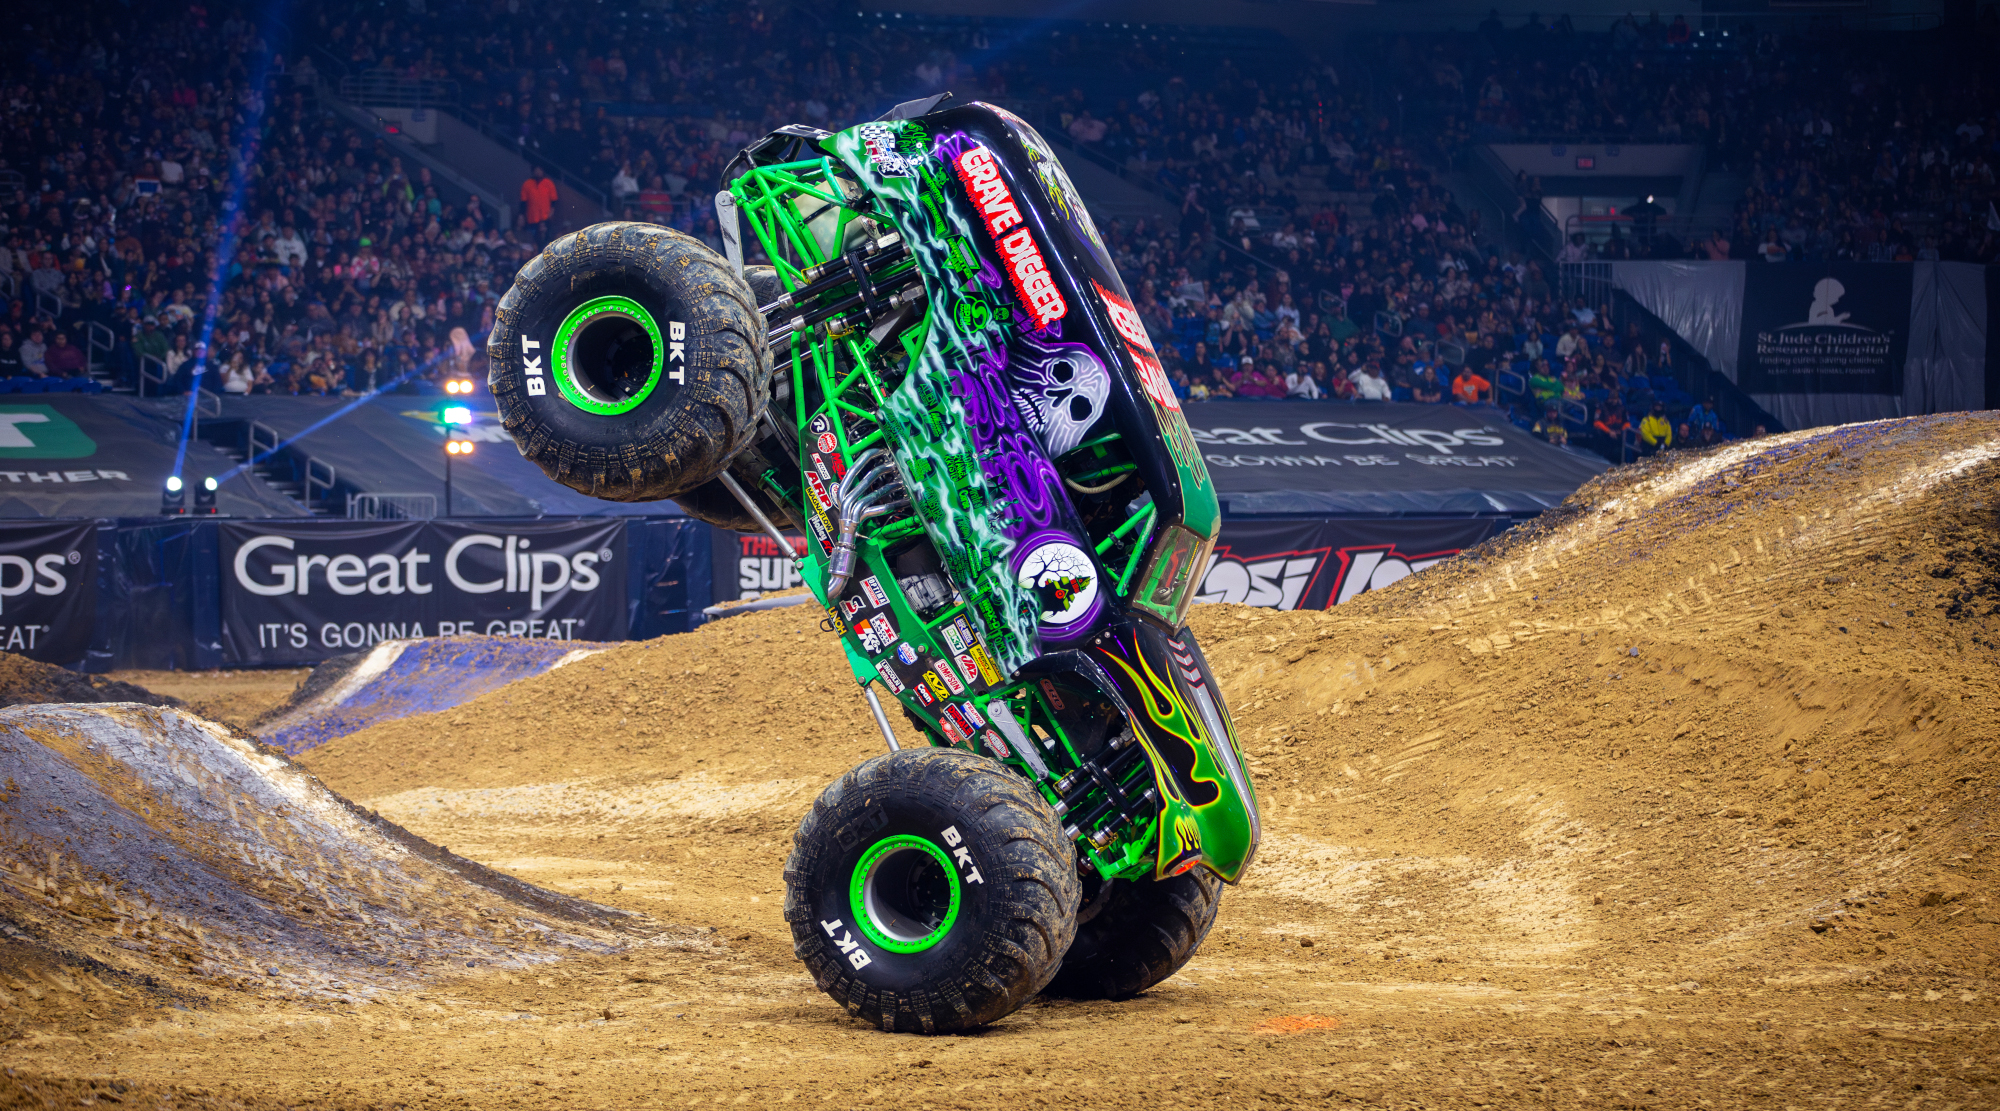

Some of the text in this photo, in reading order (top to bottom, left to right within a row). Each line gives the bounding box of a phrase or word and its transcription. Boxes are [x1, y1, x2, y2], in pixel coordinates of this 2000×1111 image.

[957, 146, 1066, 328] GRAVE DIGGER
[962, 302, 972, 326] SPIN
[1757, 344, 1889, 356] Research Hospital
[1758, 332, 1890, 345] St. Jude Children's
[521, 335, 546, 397] BKT
[669, 321, 685, 385] BKT
[1759, 356, 1791, 365] Finding
[920, 381, 938, 407] ALIEN
[959, 450, 977, 474] ADAM
[1205, 454, 1342, 467] GONNA
[1344, 454, 1399, 466] BE
[806, 469, 833, 510] ARP
[805, 487, 833, 532] MAGNAFLOW
[809, 516, 829, 542] Holley
[740, 536, 779, 556] THE
[234, 535, 432, 596] Great
[867, 578, 887, 604] OPTIMA
[981, 598, 1002, 630] MAX-D
[259, 623, 308, 648] IT'S
[321, 622, 424, 647] GONNA
[487, 619, 577, 642] GREAT
[946, 627, 965, 652] BKT
[880, 660, 901, 687] LINCOLN
[937, 662, 961, 691] SIMPSON
[960, 653, 980, 680] JAZ
[916, 683, 933, 704] Coan
[946, 705, 974, 737] DERALE
[941, 825, 984, 886] BKT
[821, 919, 872, 971] BKT
